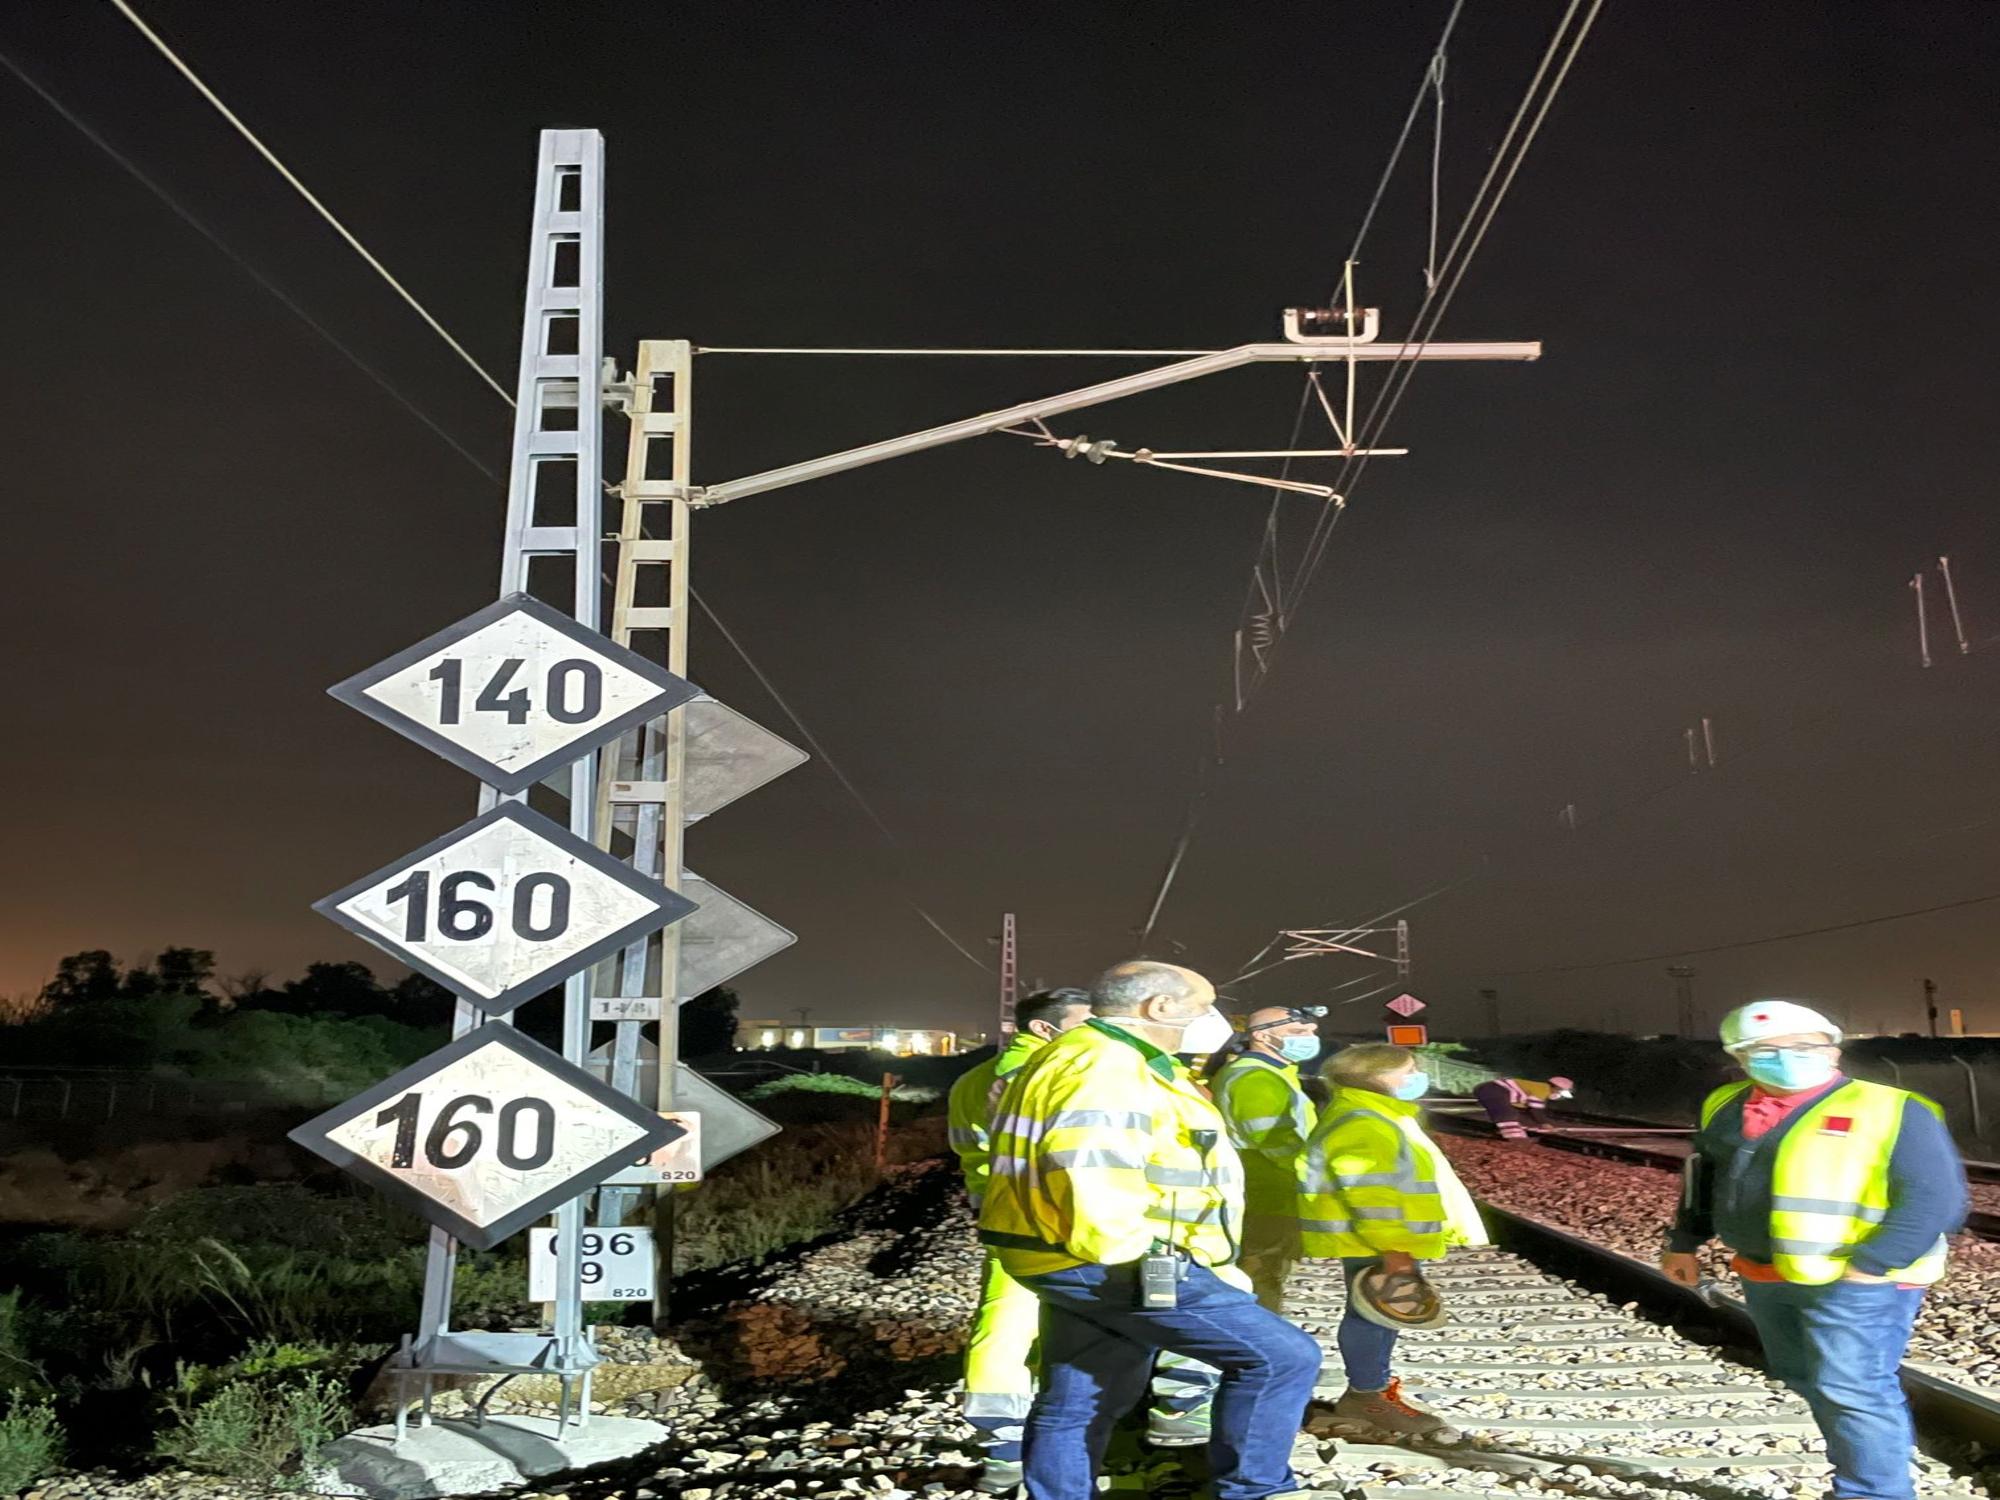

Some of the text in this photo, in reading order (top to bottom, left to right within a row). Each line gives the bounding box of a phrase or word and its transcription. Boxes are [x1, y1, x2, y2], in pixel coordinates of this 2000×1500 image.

[428, 657, 604, 726] 140
[386, 868, 571, 943] 160
[376, 1092, 556, 1171] 160
[661, 1170, 697, 1180] 820
[612, 1287, 648, 1298] 820
